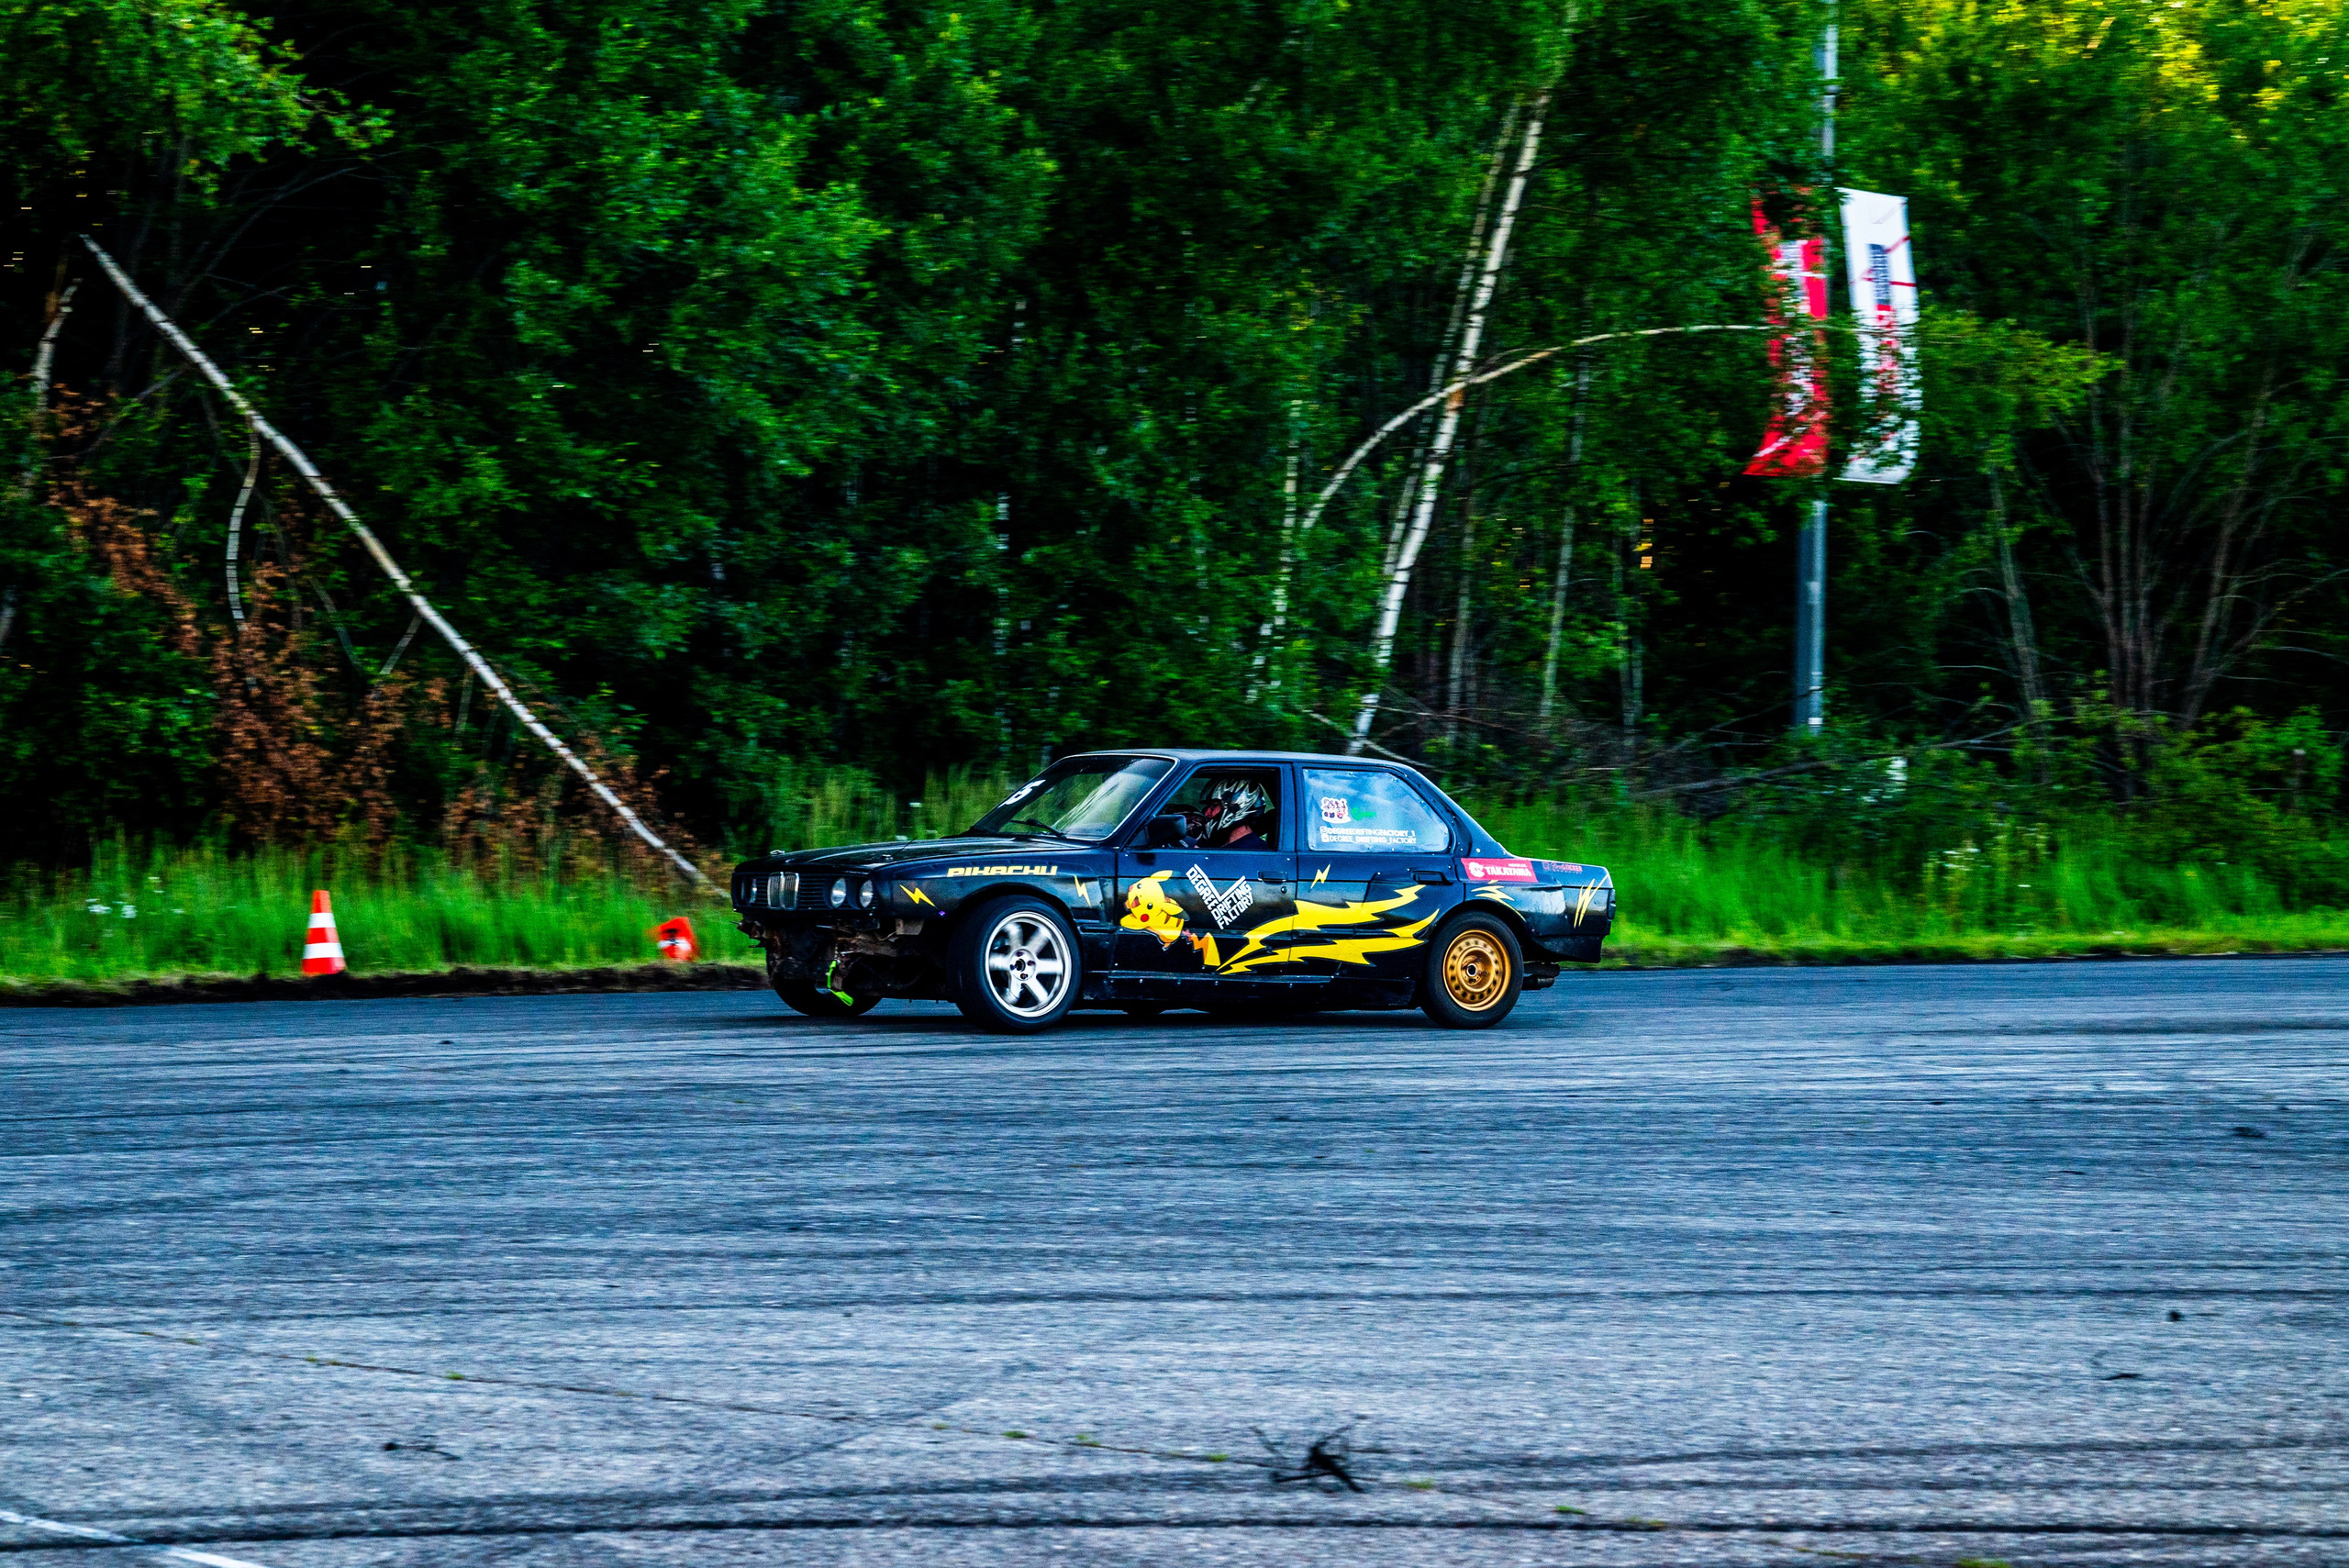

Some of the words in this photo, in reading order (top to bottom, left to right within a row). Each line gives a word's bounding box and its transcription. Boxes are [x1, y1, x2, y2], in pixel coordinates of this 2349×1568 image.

[947, 866, 1058, 877] PIKACHU
[1186, 866, 1219, 910] DEGREE
[1485, 866, 1531, 876] TAKAYAMA
[1211, 881, 1252, 920] DRIFTING
[1217, 892, 1253, 929] FACTORY
